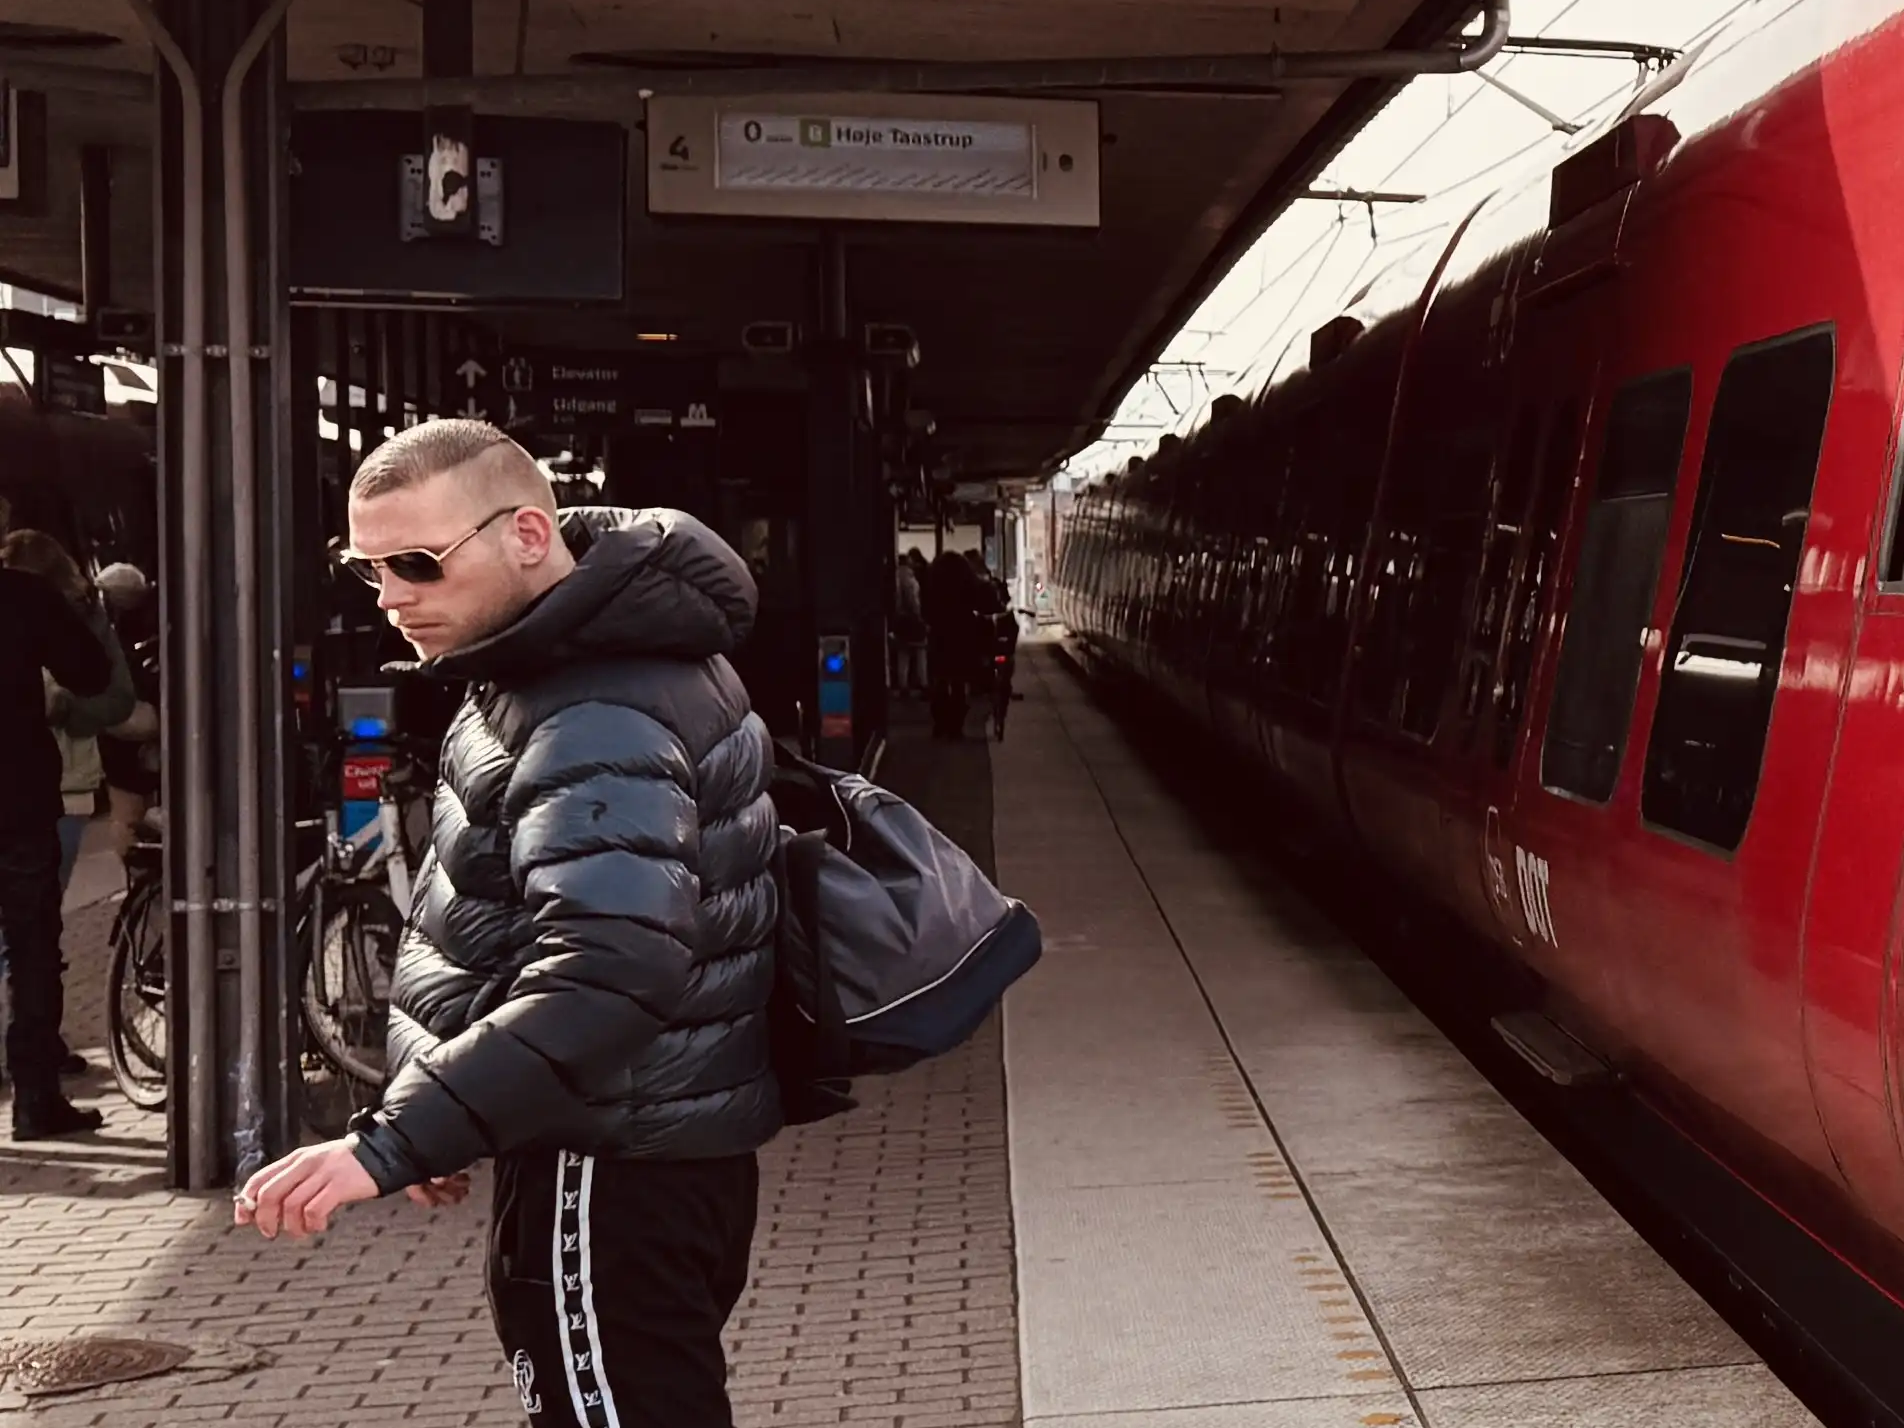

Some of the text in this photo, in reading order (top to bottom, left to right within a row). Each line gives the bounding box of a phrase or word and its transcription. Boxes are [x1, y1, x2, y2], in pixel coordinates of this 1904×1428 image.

[669, 136, 690, 161] 4
[836, 125, 883, 146] Høje
[890, 128, 973, 150] Taastrup
